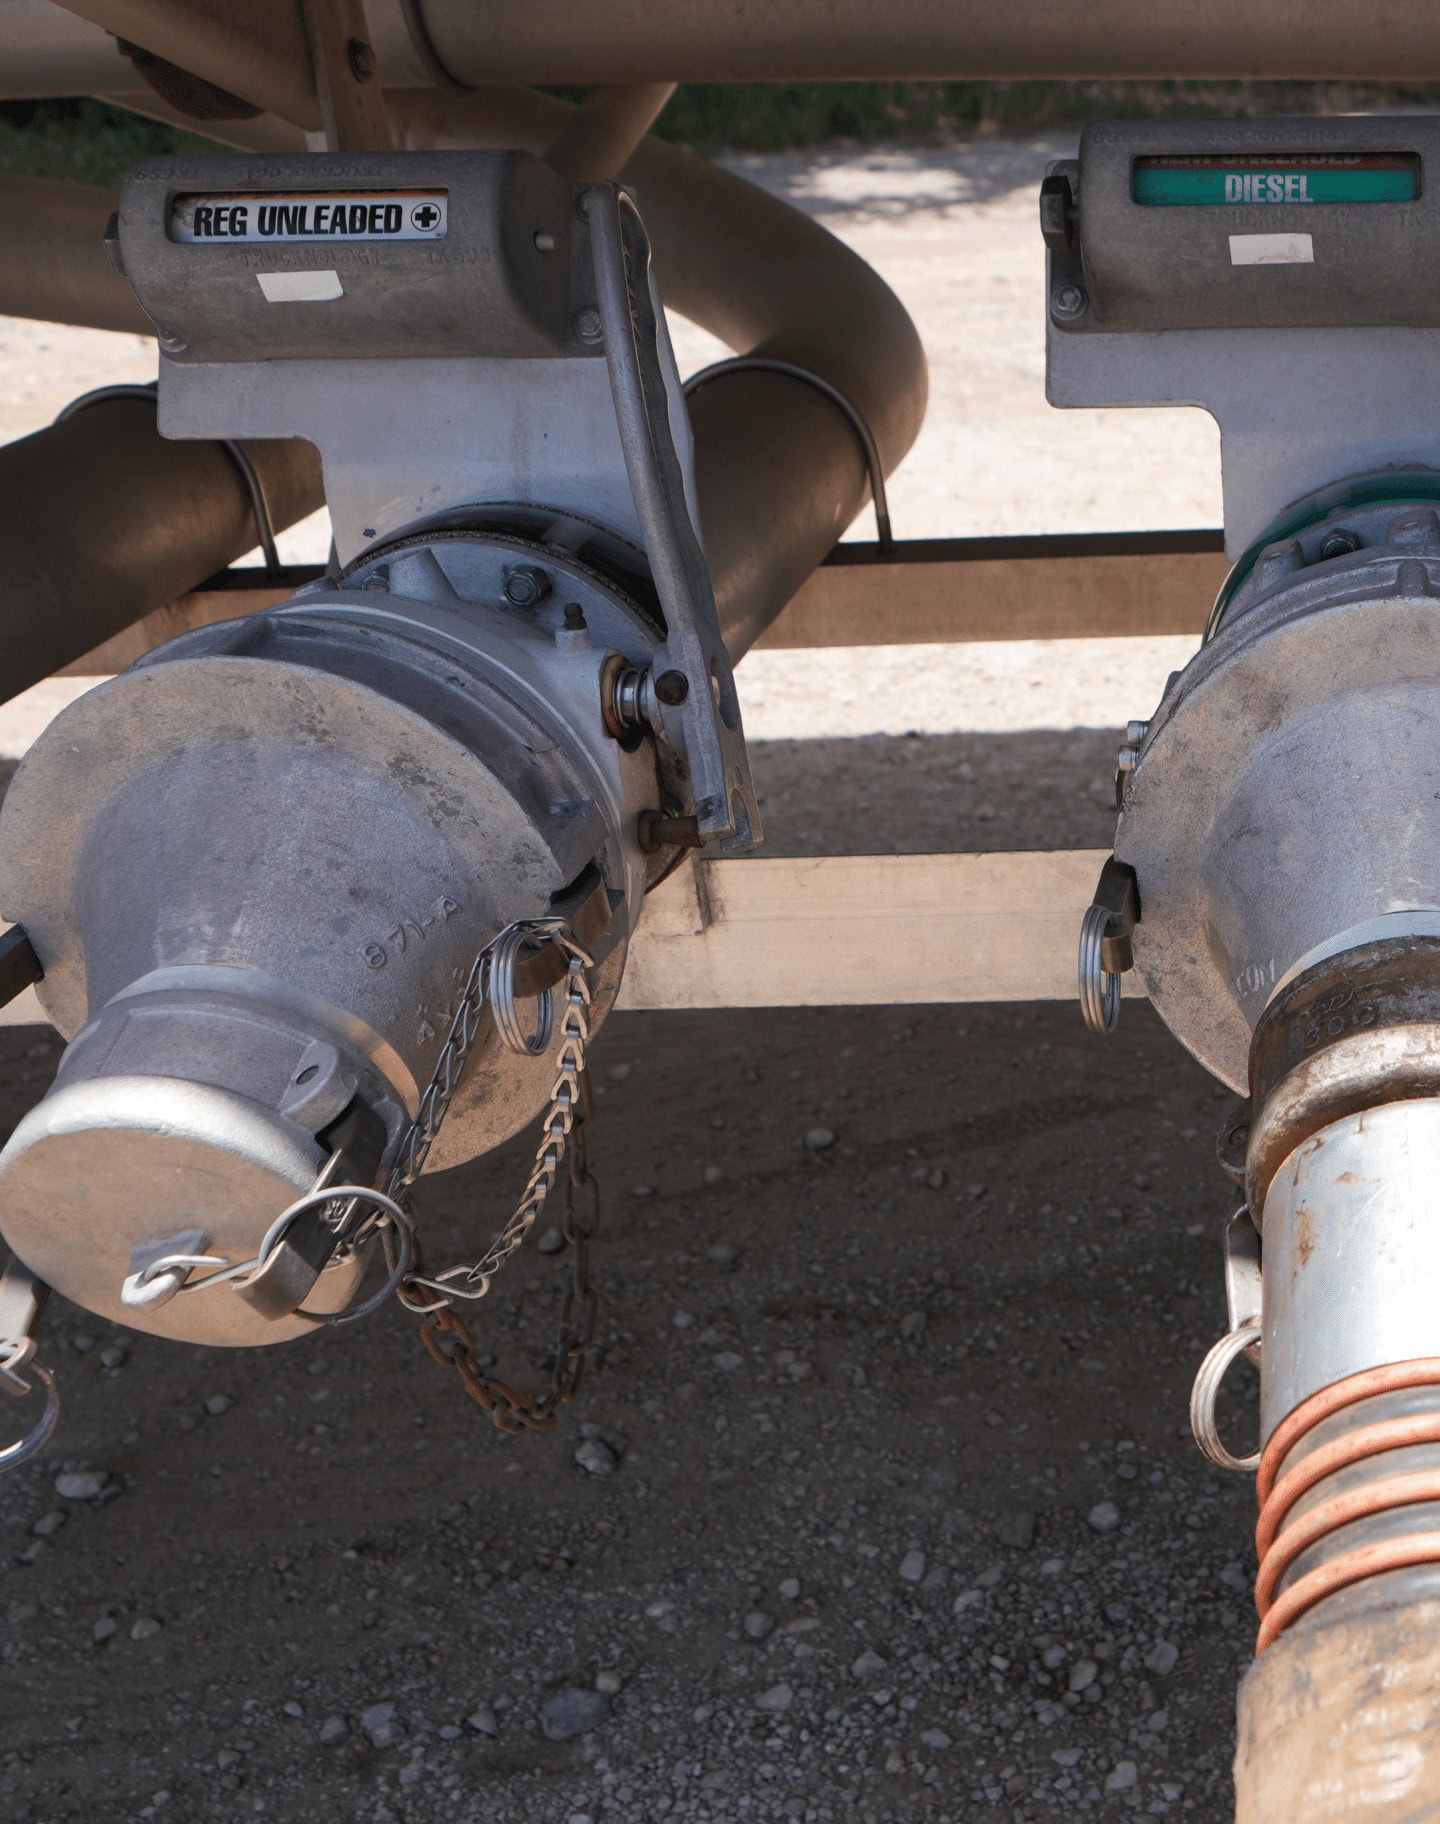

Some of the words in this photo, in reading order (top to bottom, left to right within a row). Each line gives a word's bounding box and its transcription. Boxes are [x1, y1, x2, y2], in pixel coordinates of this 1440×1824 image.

[1224, 174, 1314, 203] DIESEL
[193, 206, 248, 237] REG
[257, 204, 403, 235] UNLEADED
